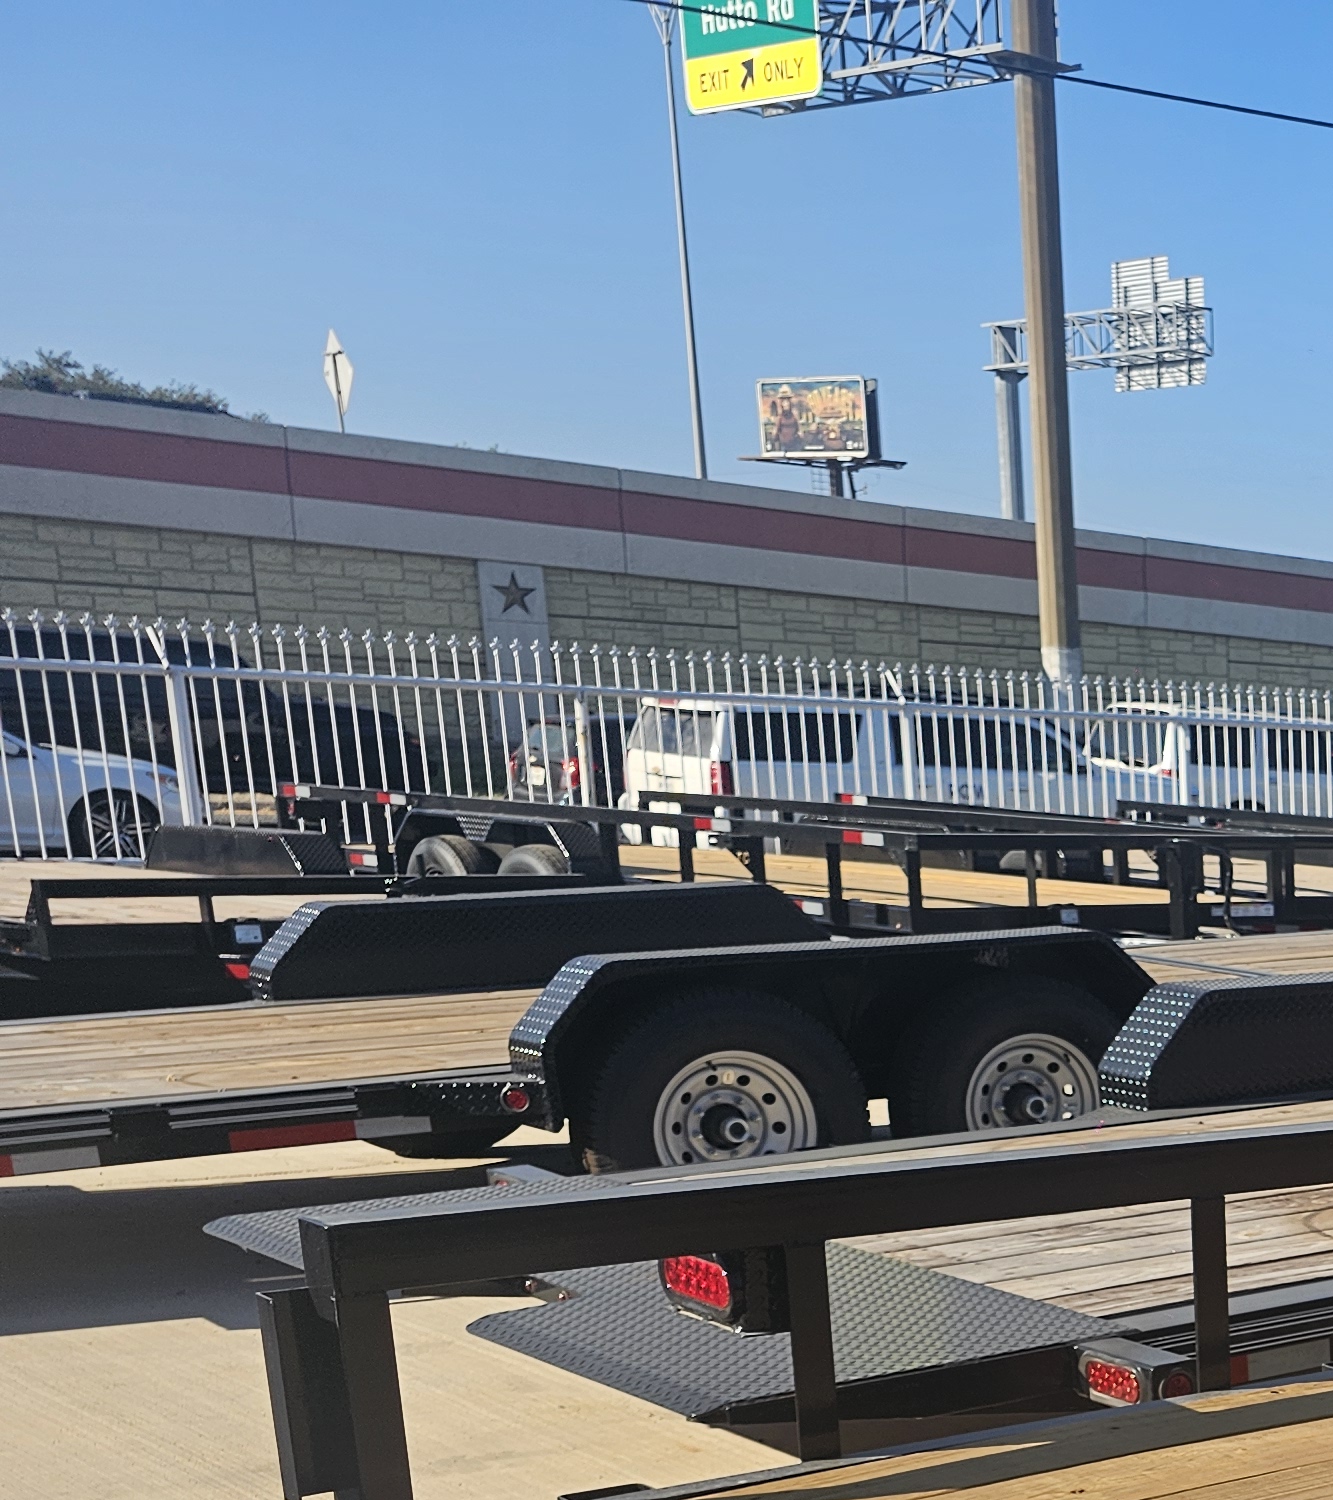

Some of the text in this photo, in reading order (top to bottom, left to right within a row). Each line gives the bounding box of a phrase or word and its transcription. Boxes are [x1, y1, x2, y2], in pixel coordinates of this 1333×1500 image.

[701, 0, 757, 35] Hutto
[700, 57, 804, 93] EXIT ONLY
